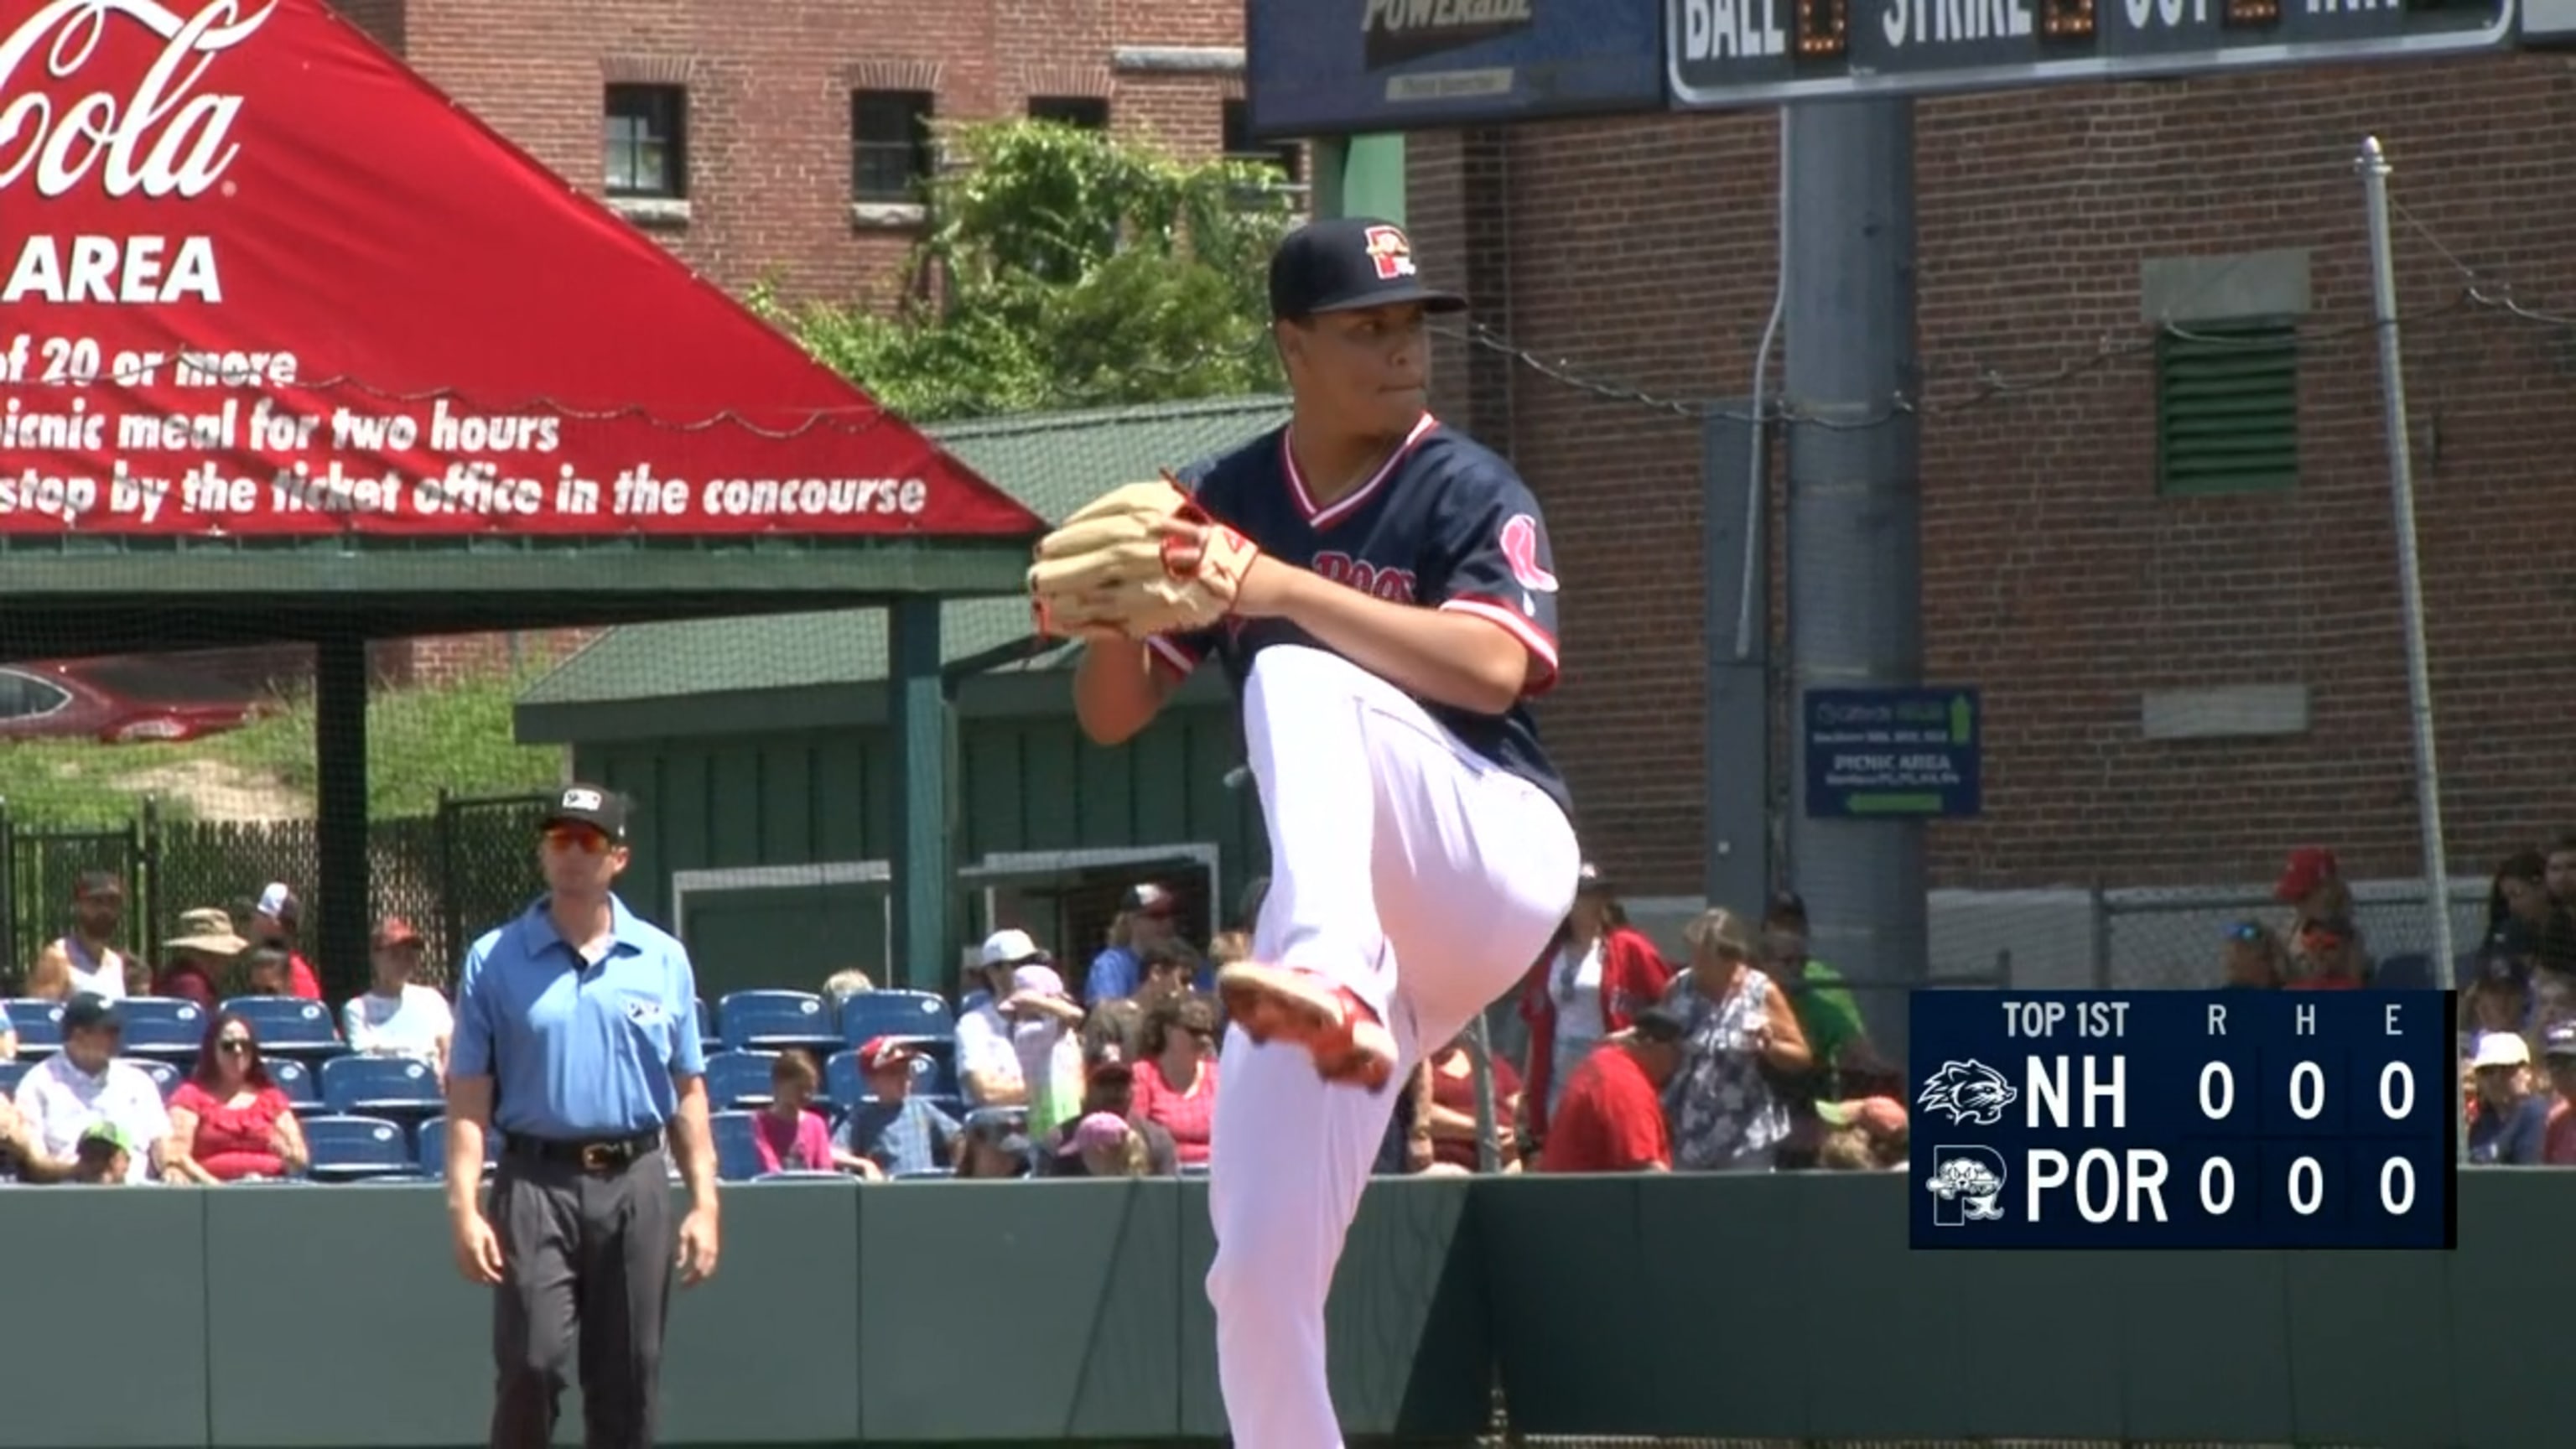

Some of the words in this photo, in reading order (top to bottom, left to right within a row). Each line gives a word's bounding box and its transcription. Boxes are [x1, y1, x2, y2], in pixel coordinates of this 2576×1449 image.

[1, 235, 222, 303] AREA
[0, 334, 31, 382] f
[40, 337, 100, 387] 20
[112, 351, 164, 387] or
[176, 351, 298, 387] more
[0, 397, 106, 450] icnic
[117, 399, 238, 450] meal
[251, 398, 319, 450] for
[332, 406, 417, 450] two
[430, 399, 559, 452] hours
[0, 468, 96, 523] stop
[110, 460, 170, 523] by
[181, 461, 254, 513] the
[272, 461, 401, 513] ticket
[413, 463, 543, 514] office
[556, 464, 599, 514] in
[613, 464, 688, 514] the
[703, 477, 926, 514] concourse
